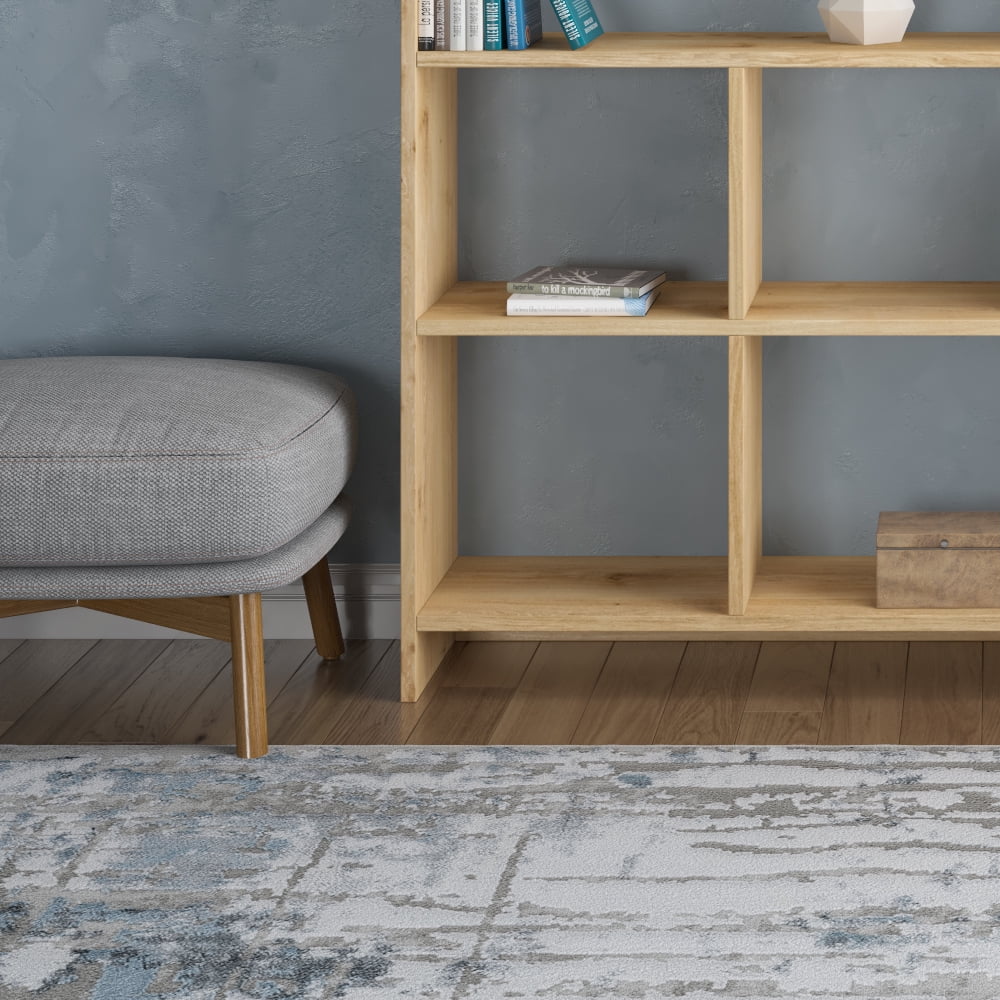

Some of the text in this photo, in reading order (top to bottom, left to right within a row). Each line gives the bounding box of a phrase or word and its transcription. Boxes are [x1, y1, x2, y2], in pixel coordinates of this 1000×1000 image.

[487, 2, 498, 42] SILENT VOICES
[563, 18, 581, 41] SILENT
[551, 285, 560, 293] kill
[568, 286, 610, 297] mockingbird
